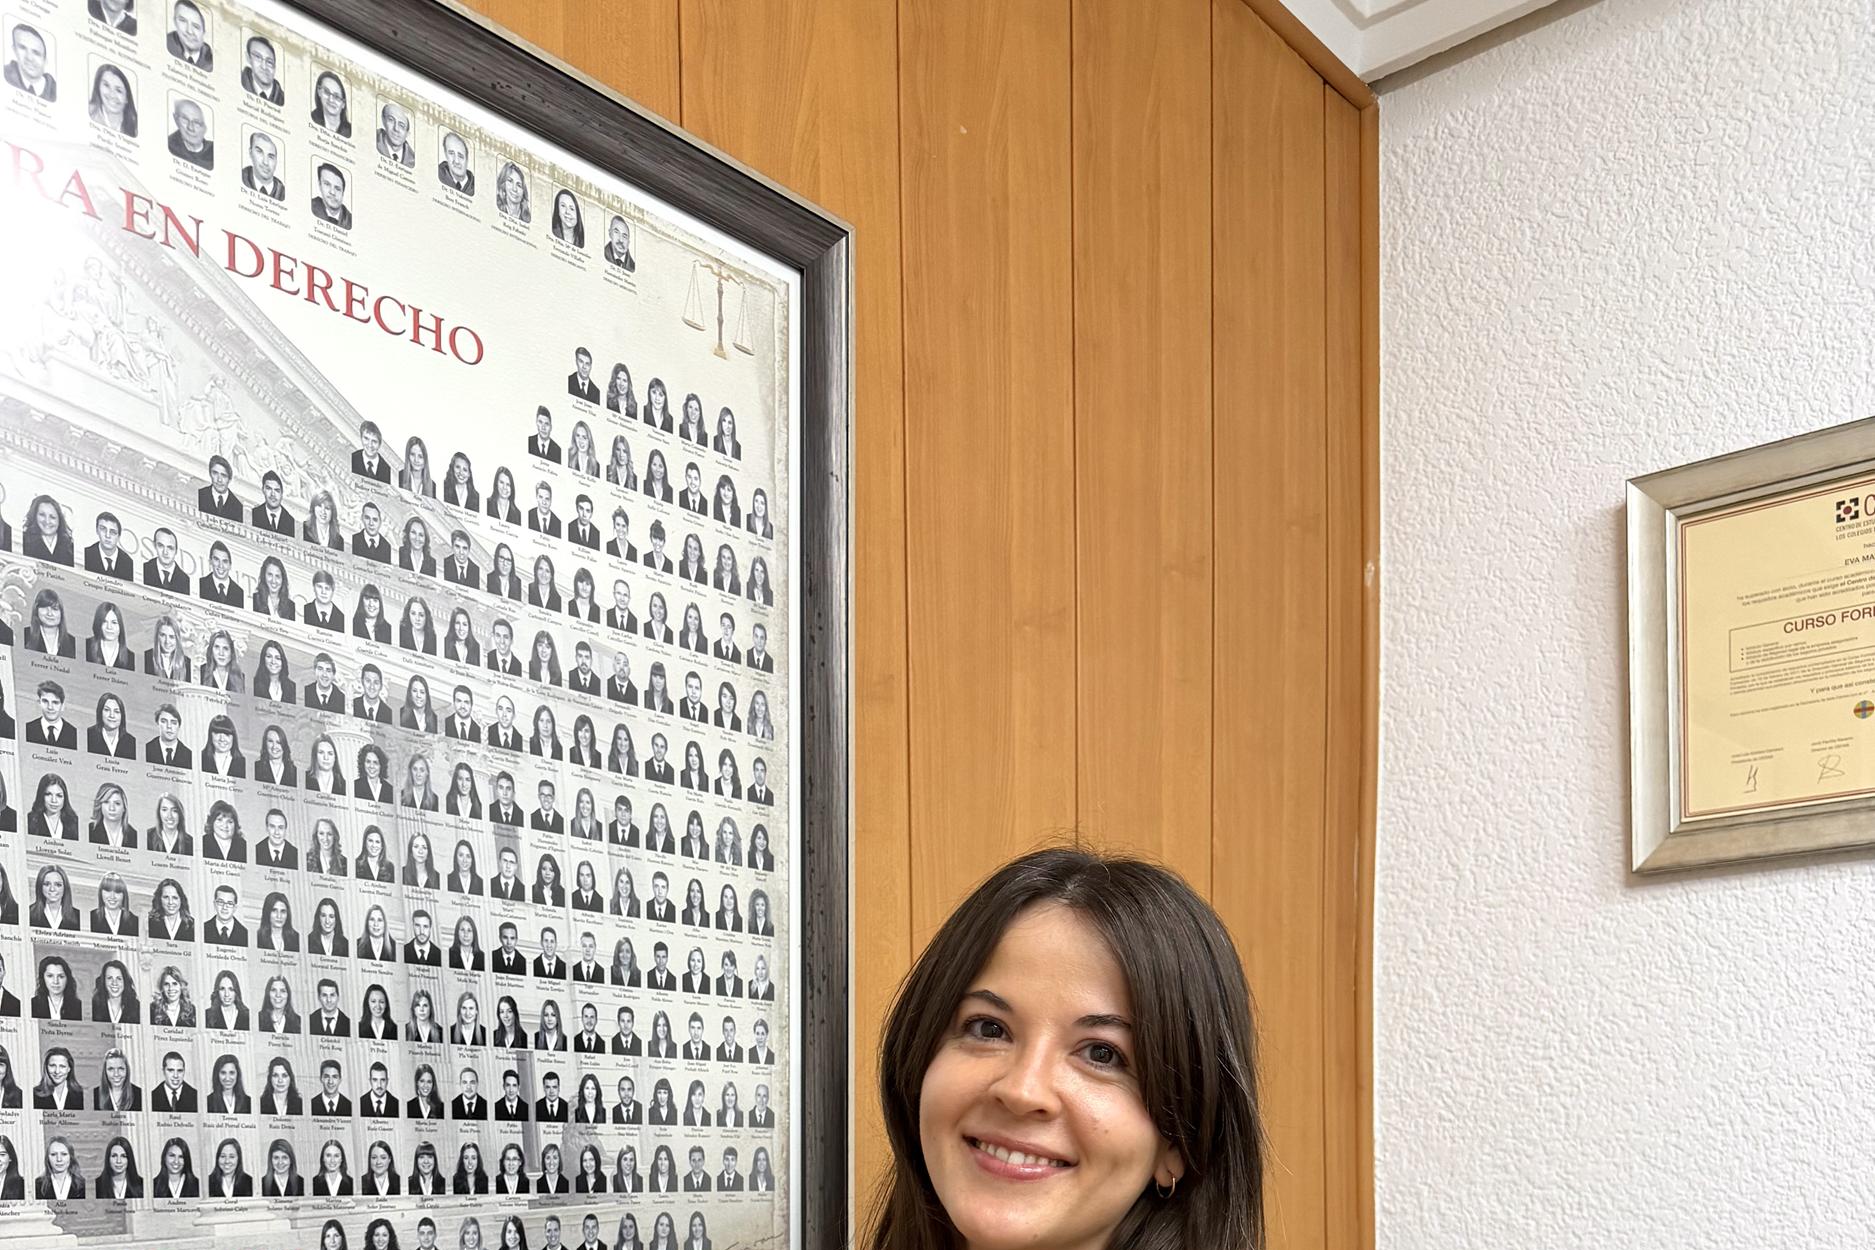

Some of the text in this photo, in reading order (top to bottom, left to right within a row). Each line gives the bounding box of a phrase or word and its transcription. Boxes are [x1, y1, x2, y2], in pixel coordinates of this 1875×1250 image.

[118, 187, 204, 258] EN
[222, 229, 485, 366] DERECHO
[1844, 556, 1860, 566] EVA
[1783, 613, 1836, 634] CURSO
[42, 653, 59, 665] Adela
[30, 659, 47, 670] Ferrer
[53, 663, 70, 675] Nadal
[92, 672, 109, 683] Ferrer
[111, 765, 128, 775] Ferrer
[163, 1026, 184, 1035] Caridad
